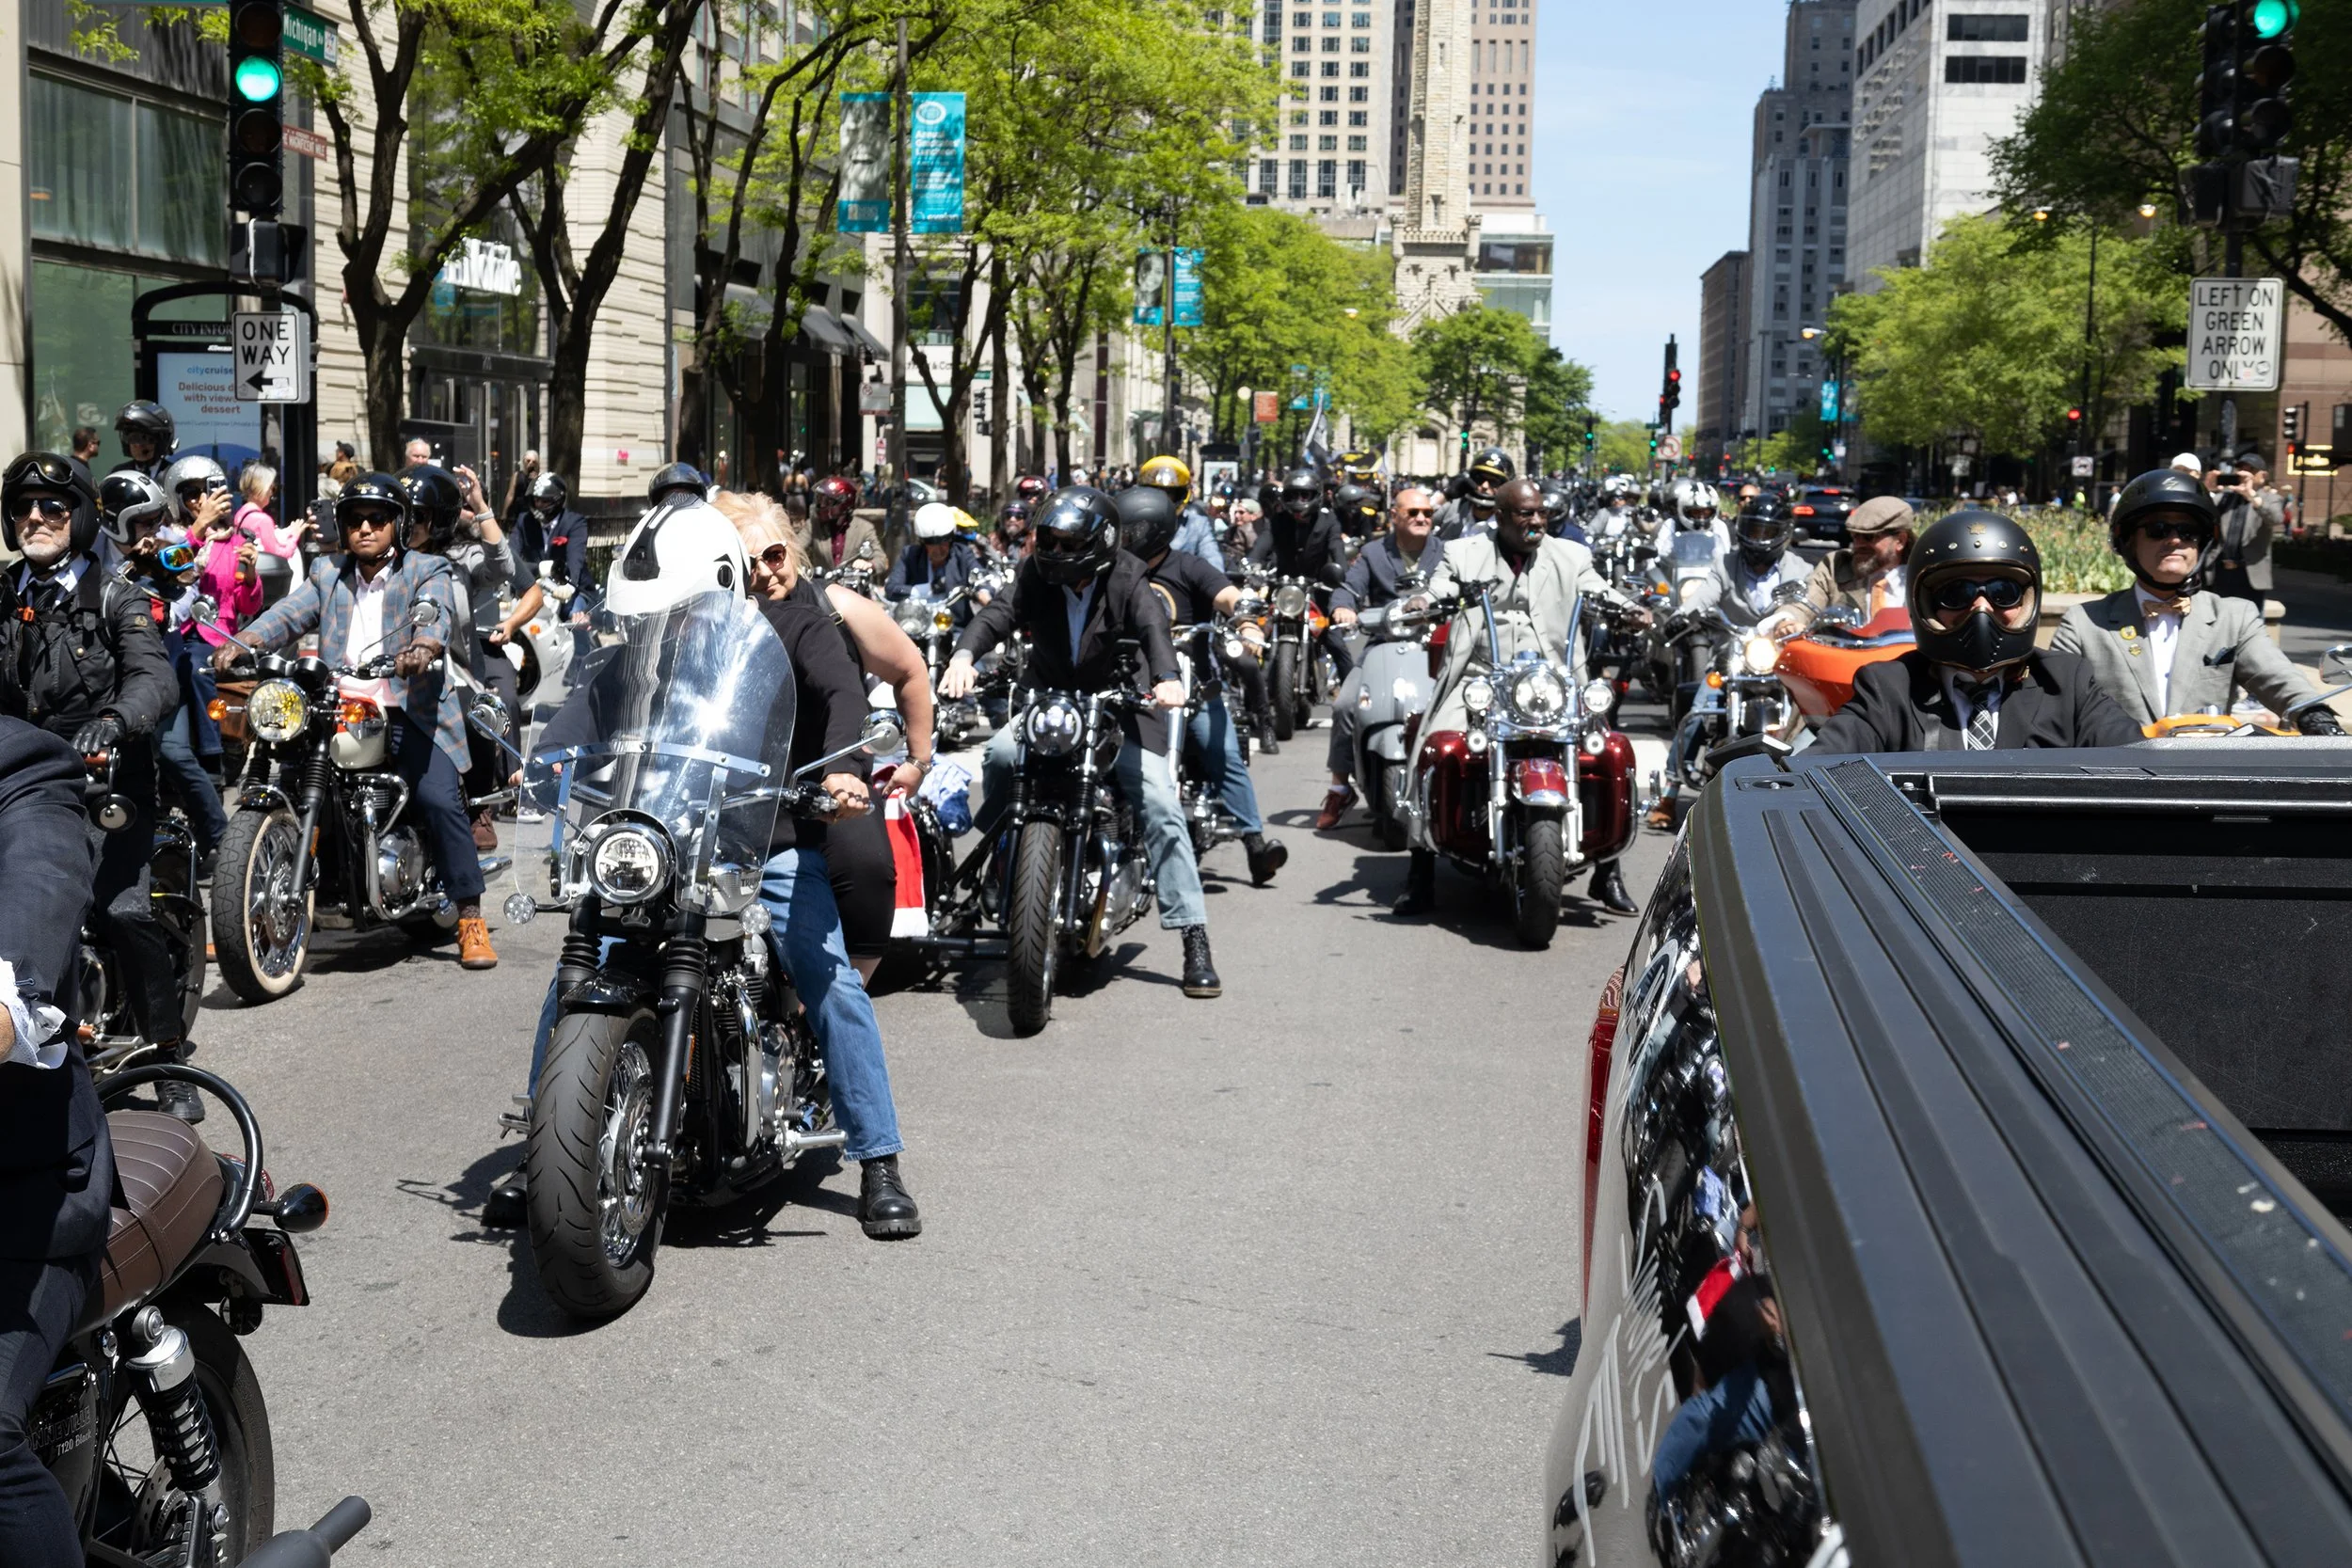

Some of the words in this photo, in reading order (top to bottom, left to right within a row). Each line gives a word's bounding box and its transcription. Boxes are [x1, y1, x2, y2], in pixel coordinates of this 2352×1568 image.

[283, 13, 317, 51] Michigan
[2198, 285, 2243, 307] LEFT
[2249, 287, 2274, 307] ON
[172, 323, 197, 335] CITY
[242, 321, 290, 341] ONE
[2205, 311, 2265, 331] GREEN
[241, 345, 291, 365] WAY
[2201, 336, 2266, 356] ARROW
[178, 382, 226, 391] Delicious
[183, 393, 206, 403] with
[200, 404, 241, 414] dessert
[56, 1438, 74, 1457] T120
[75, 1429, 92, 1447] Black
